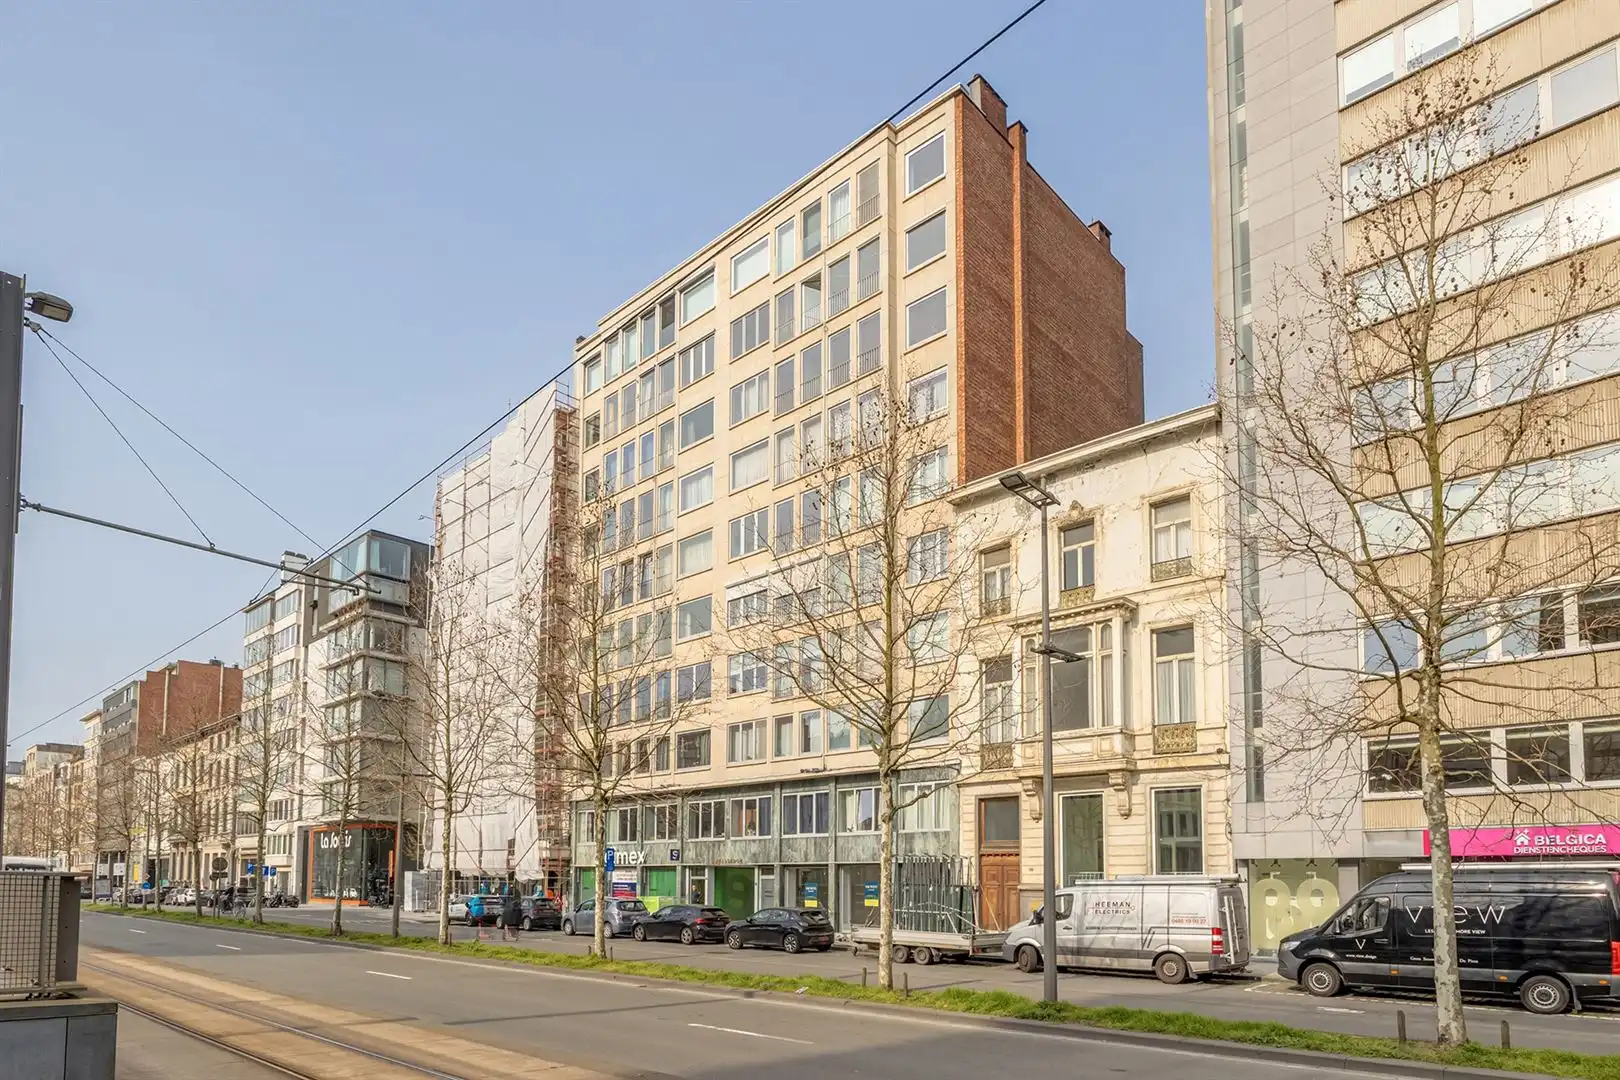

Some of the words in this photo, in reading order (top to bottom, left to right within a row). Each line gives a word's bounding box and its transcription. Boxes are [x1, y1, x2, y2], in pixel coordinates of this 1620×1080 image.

[1534, 833, 1607, 846] BELGICA
[608, 850, 614, 860] P
[1513, 845, 1607, 854] DIENSTENCHEQUES
[1405, 905, 1505, 924] vew
